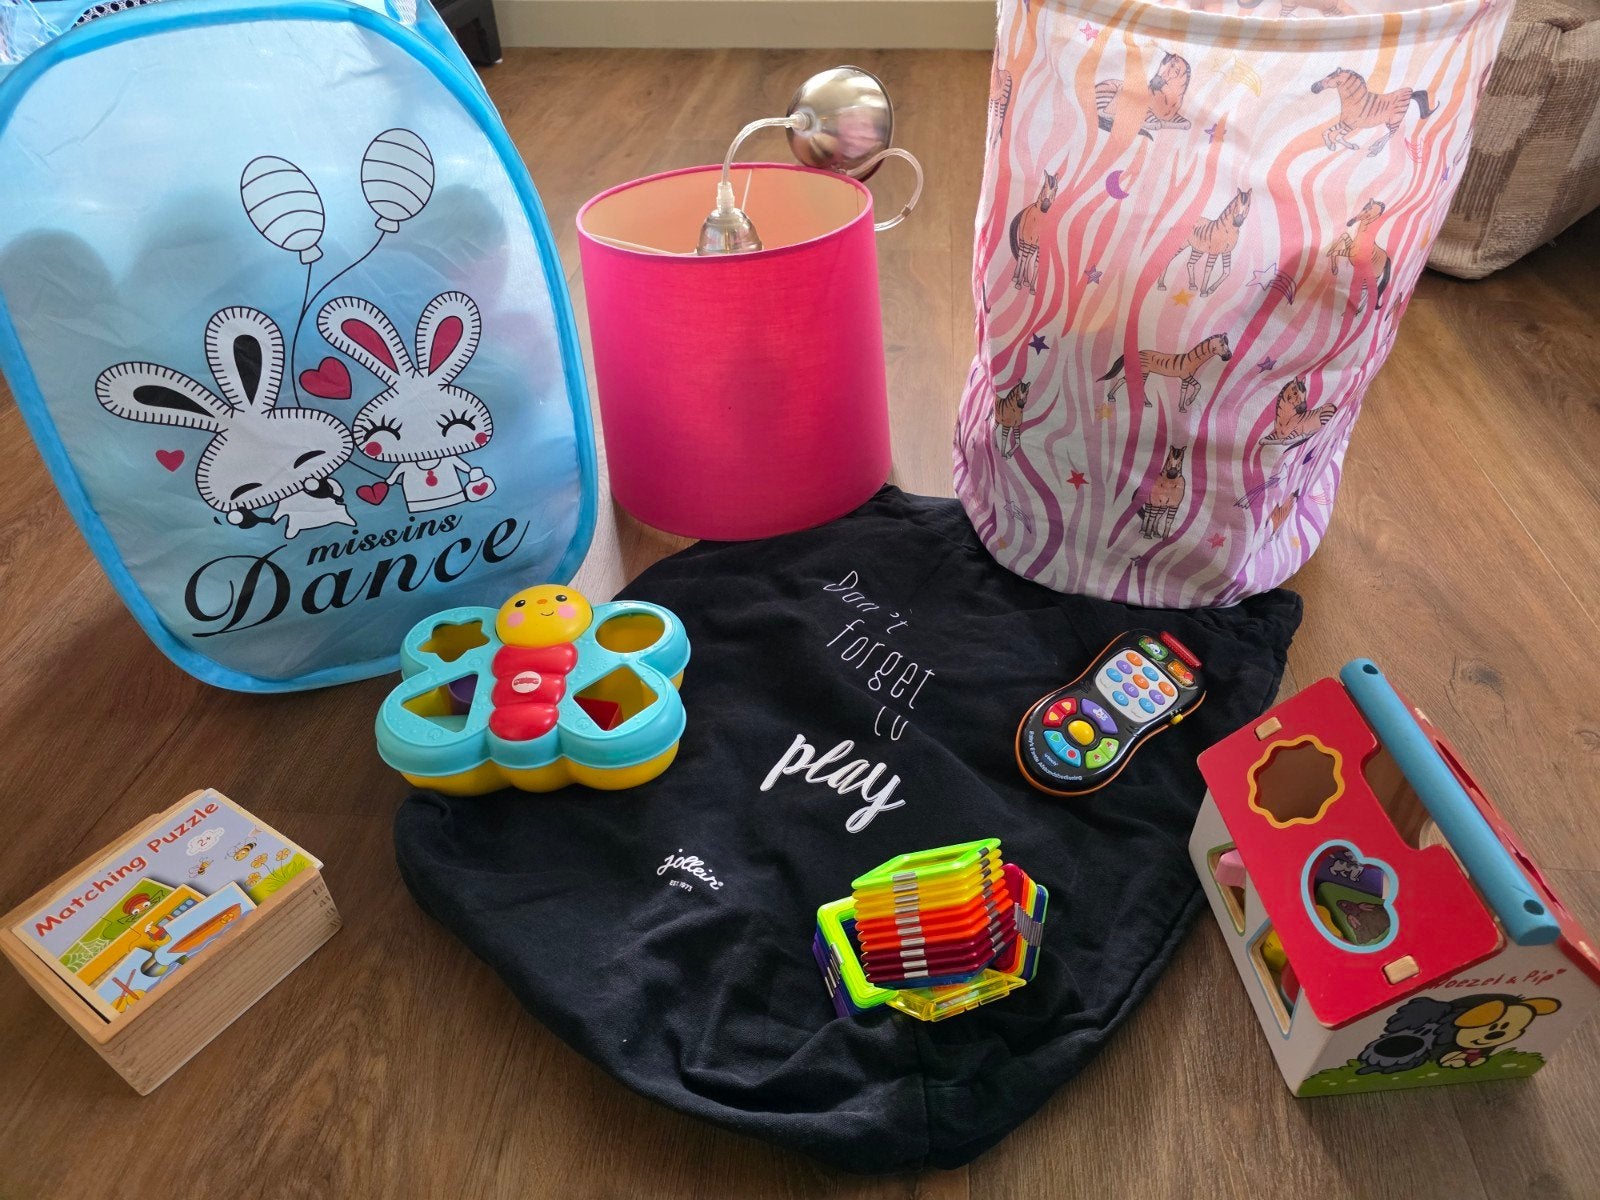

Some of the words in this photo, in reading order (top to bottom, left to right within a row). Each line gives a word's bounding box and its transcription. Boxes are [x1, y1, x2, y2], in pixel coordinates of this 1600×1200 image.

[184, 516, 531, 638] Dance
[306, 513, 463, 566] missins
[826, 619, 935, 709] forget
[759, 733, 907, 833] play
[34, 855, 148, 937] Matching
[146, 802, 219, 853] Puzzle
[197, 836, 211, 847] 2+
[1523, 969, 1555, 986] Pip
